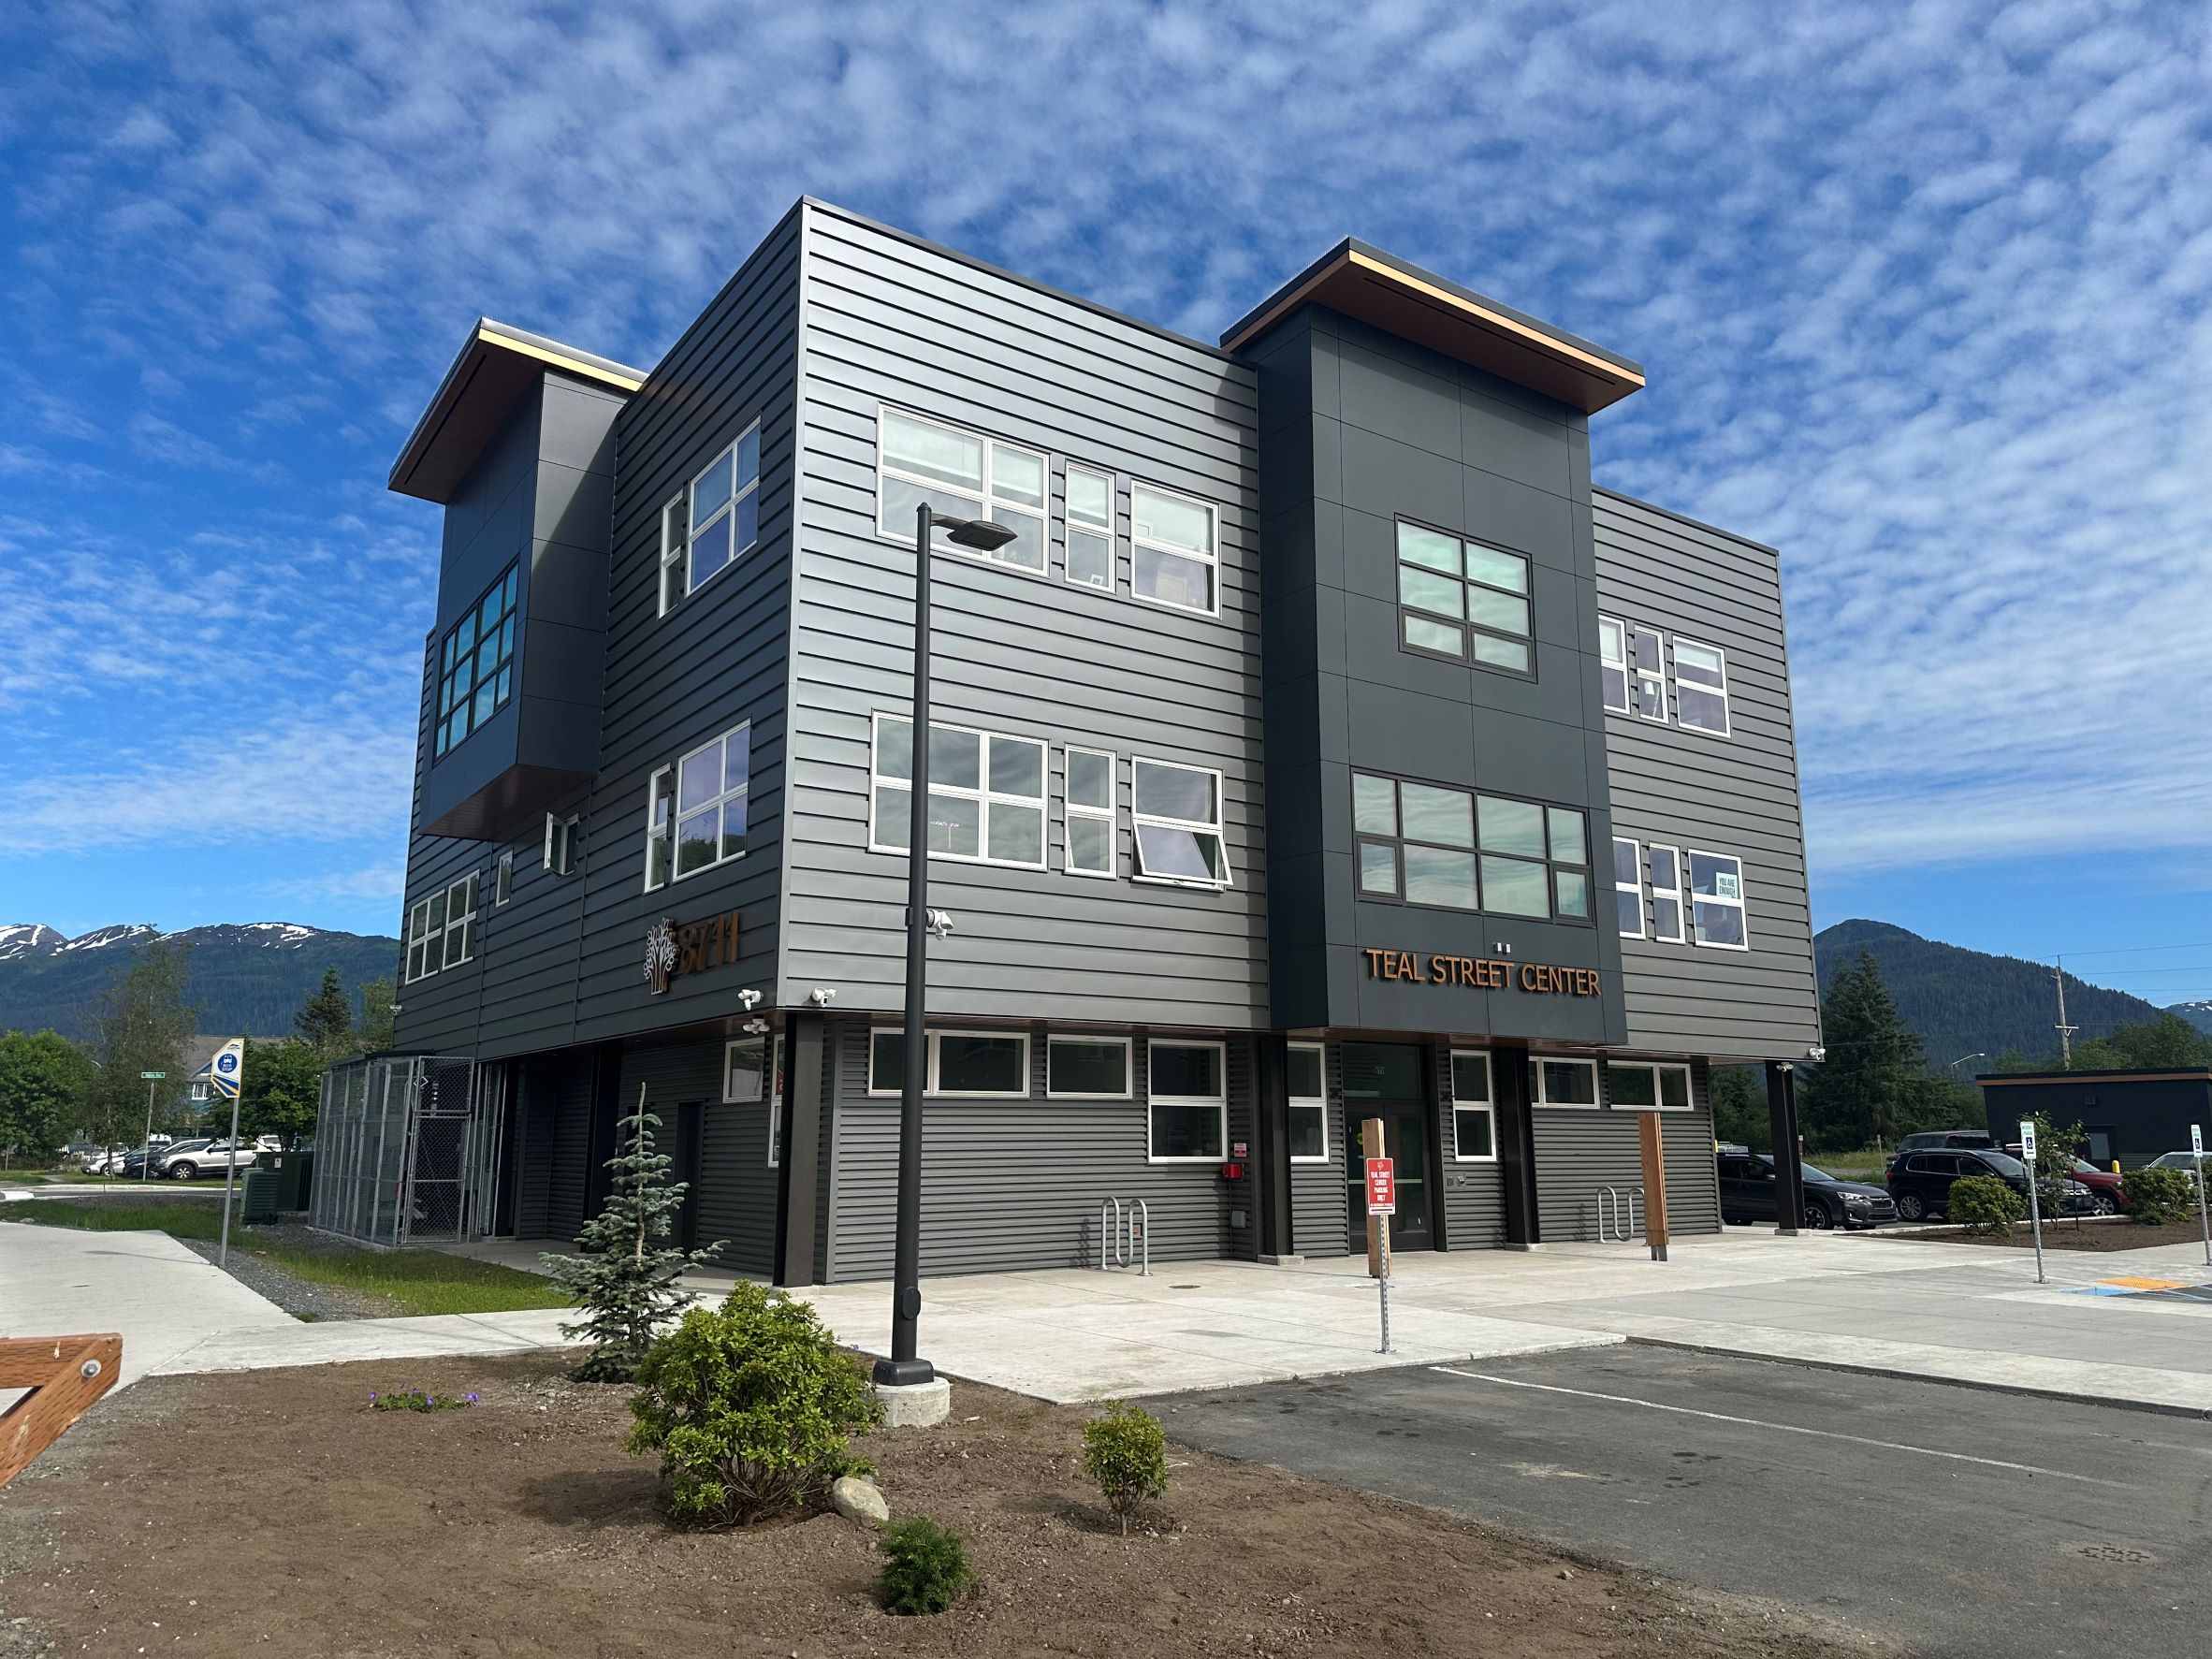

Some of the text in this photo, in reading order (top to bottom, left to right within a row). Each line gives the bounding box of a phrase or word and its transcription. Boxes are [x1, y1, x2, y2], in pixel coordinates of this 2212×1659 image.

[1719, 886, 1736, 895] ENOUGH
[1364, 948, 1602, 997] TEAL STREET CENTER
